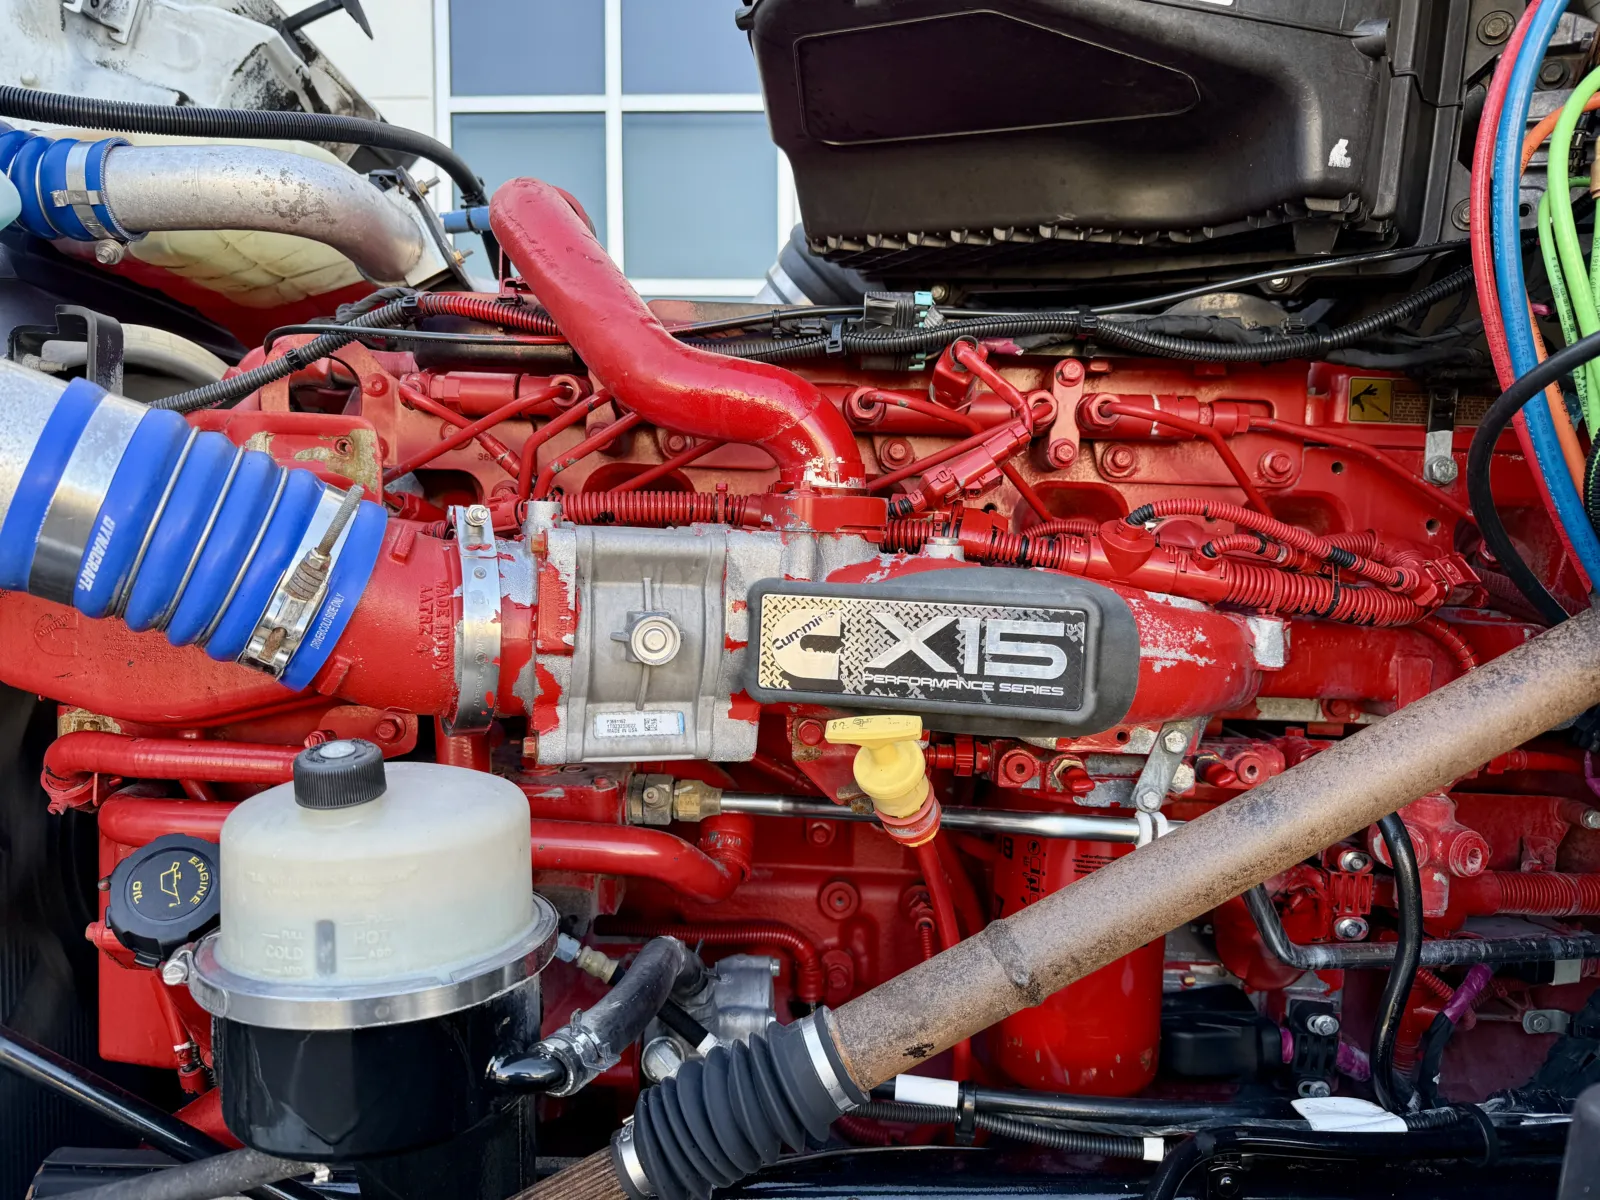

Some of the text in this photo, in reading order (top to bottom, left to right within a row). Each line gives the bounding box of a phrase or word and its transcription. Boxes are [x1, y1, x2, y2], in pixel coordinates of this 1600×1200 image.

[78, 514, 116, 592] DYNACRAFT
[436, 581, 450, 618] MADE
[772, 610, 836, 651] Cummins
[864, 612, 1068, 680] X15
[863, 672, 1064, 696] PERFORMANCE SERIES
[132, 880, 143, 905] OIL
[187, 855, 209, 905] ENGINE
[265, 945, 304, 961] COLD
